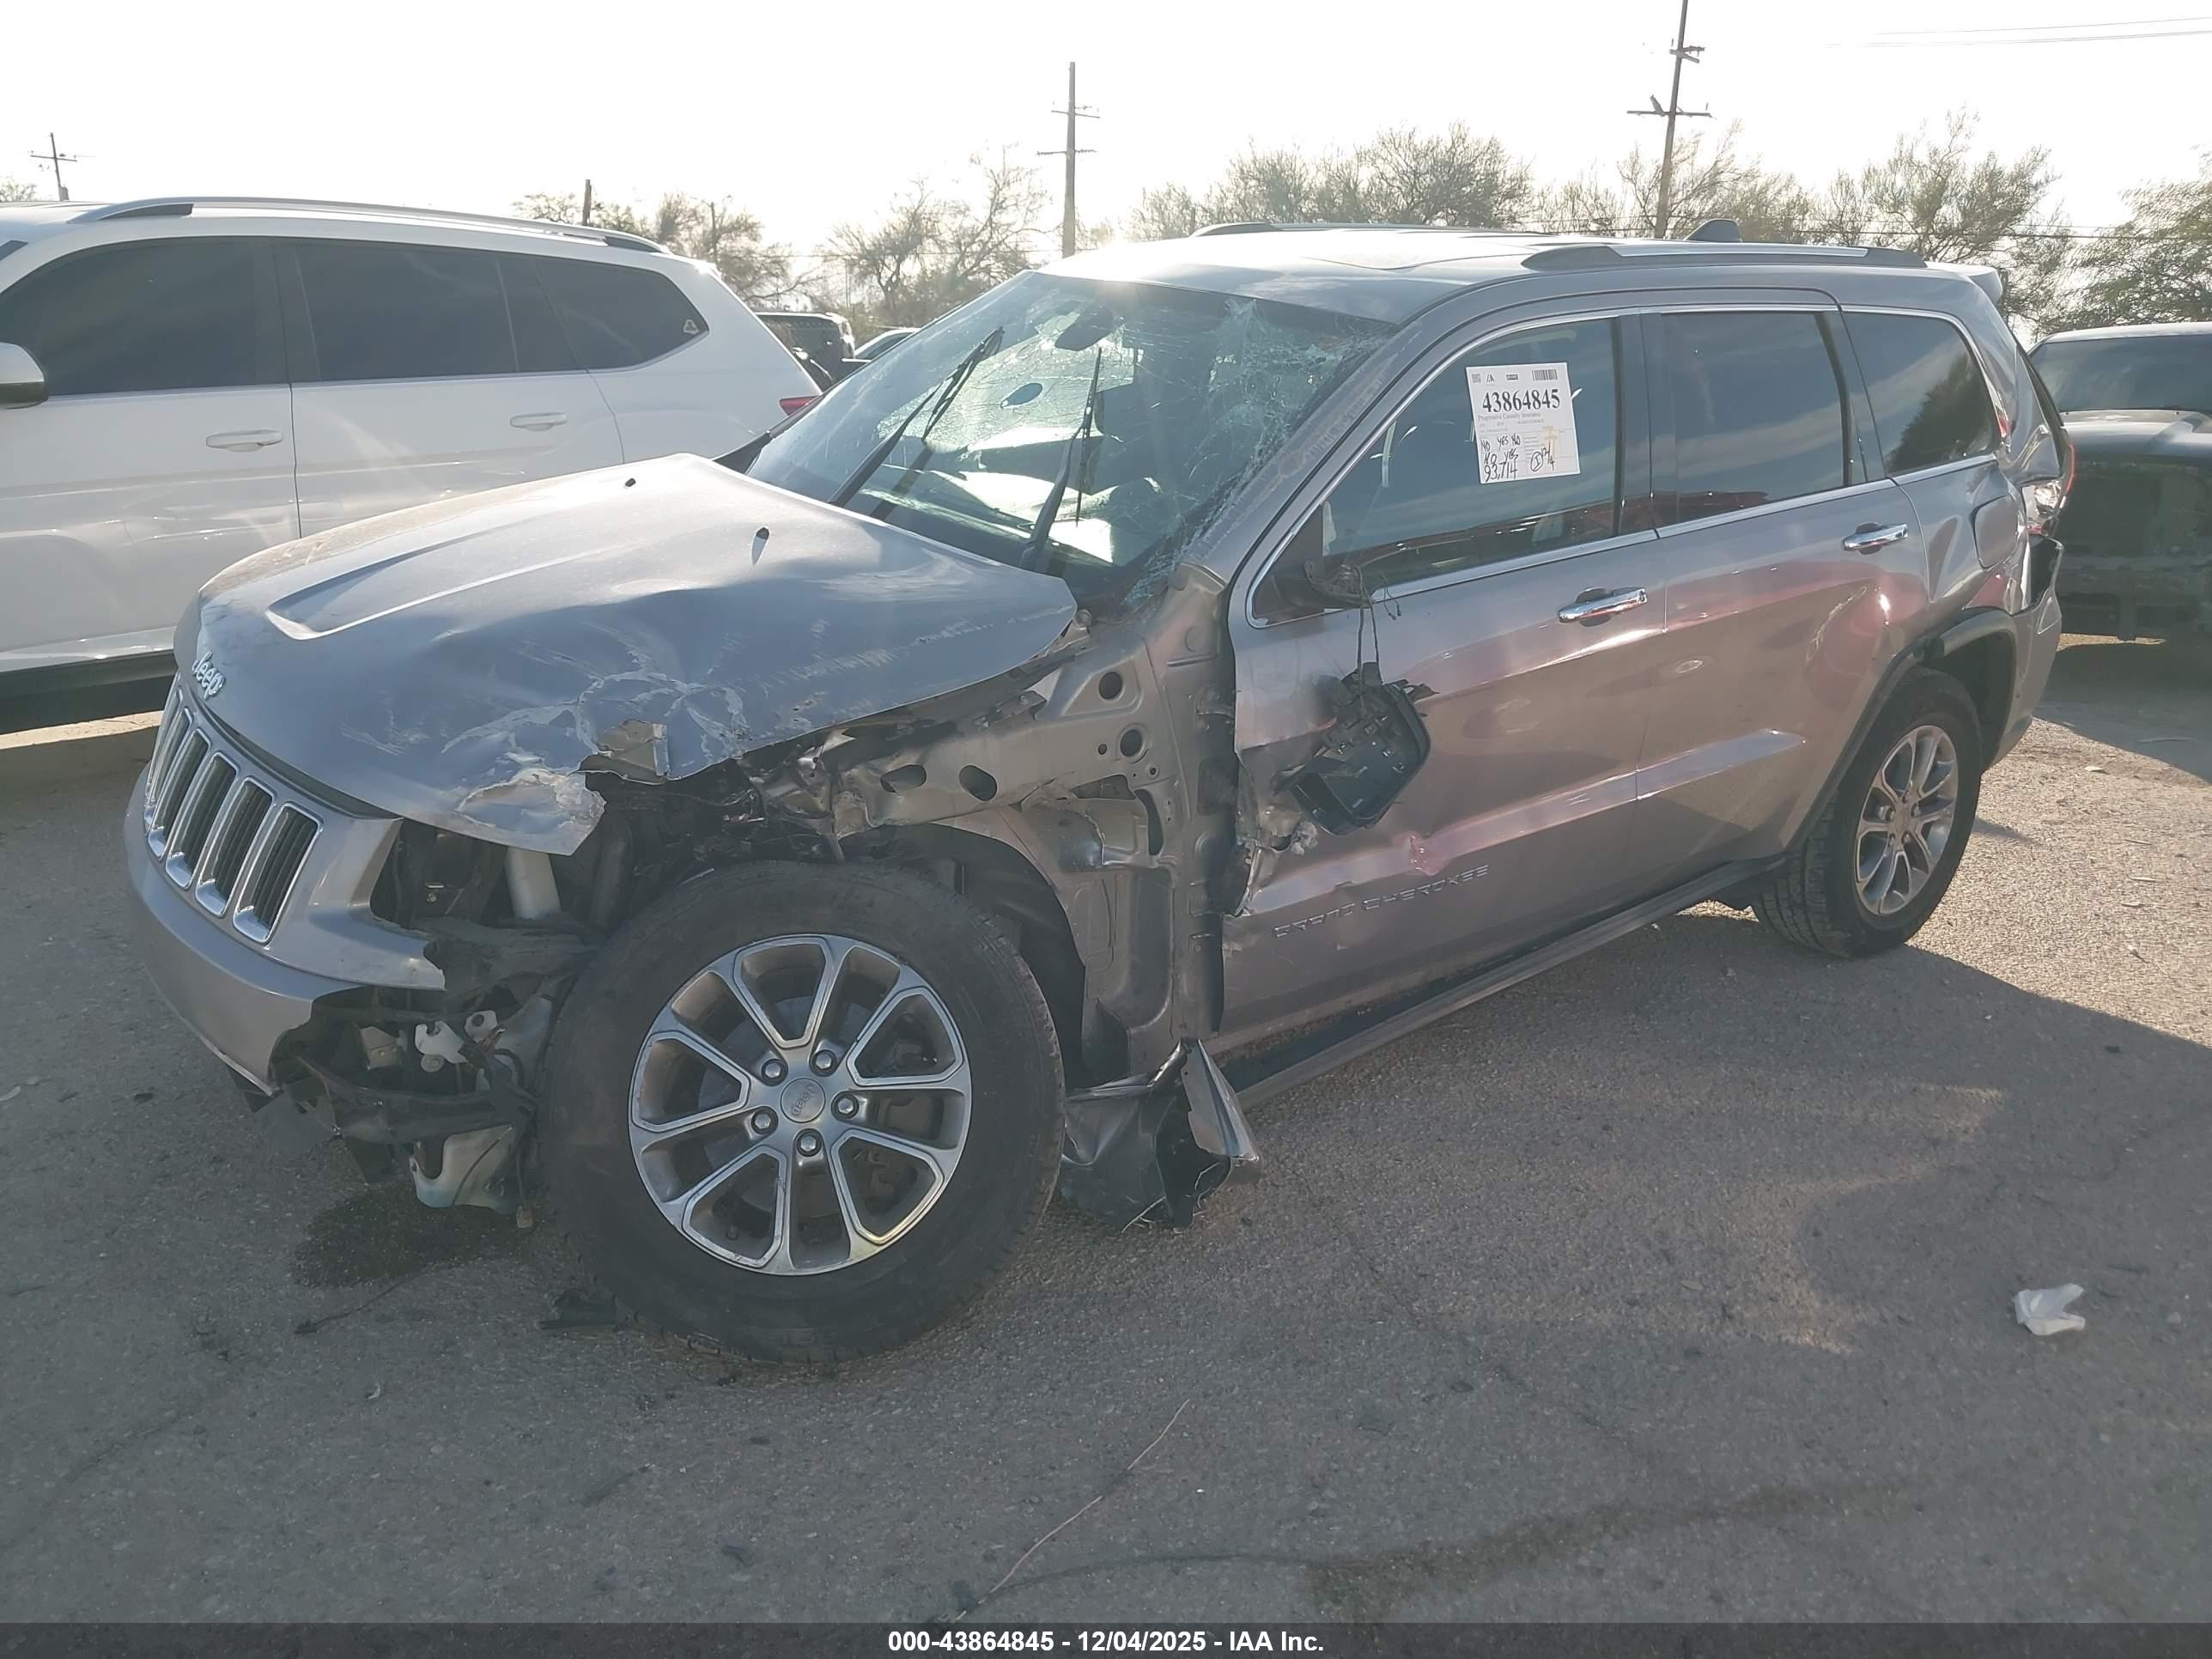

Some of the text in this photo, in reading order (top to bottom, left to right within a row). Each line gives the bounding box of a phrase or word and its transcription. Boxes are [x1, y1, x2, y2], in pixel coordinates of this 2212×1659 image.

[1482, 388, 1560, 412] 43864845
[191, 651, 226, 701] Jeep
[791, 1085, 817, 1117] Jeep
